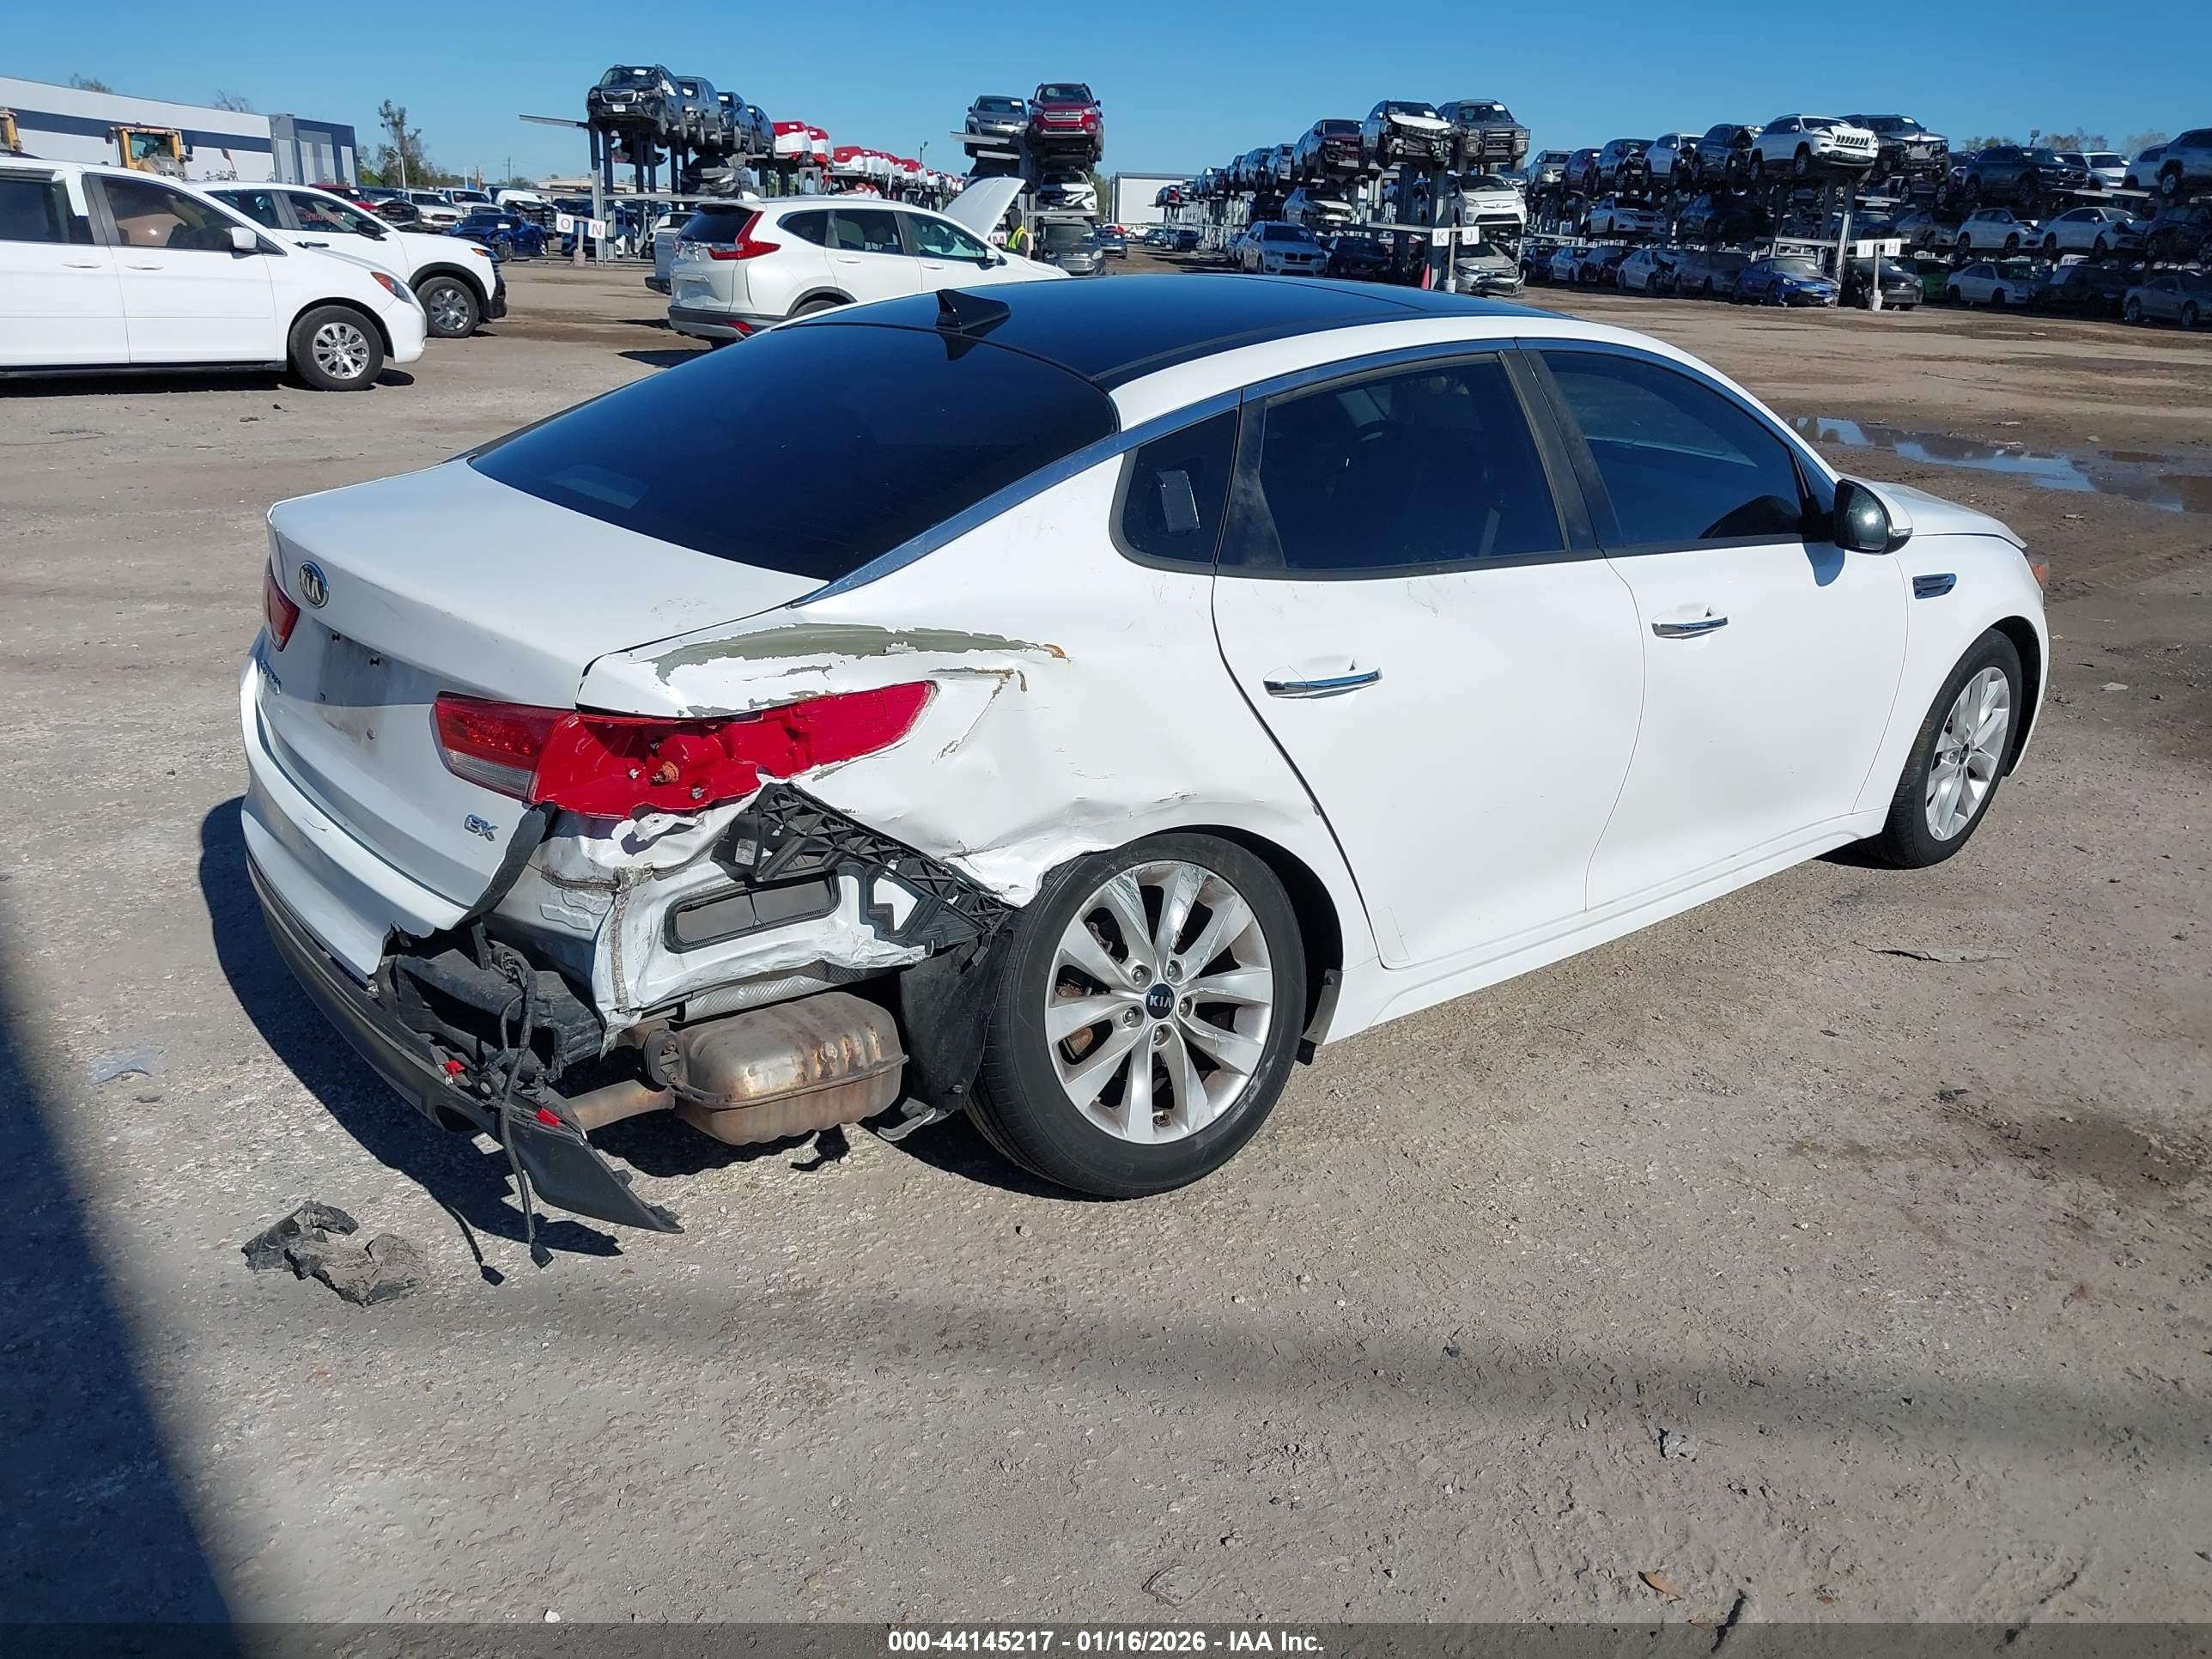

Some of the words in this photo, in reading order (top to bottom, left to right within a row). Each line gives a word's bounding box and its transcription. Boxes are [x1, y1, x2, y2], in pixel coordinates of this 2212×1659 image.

[561, 218, 571, 230] O
[592, 223, 603, 236] N
[1436, 231, 1445, 243] K
[1466, 230, 1474, 241] J
[1888, 242, 1898, 253] H
[300, 565, 322, 603] KIA
[464, 813, 499, 842] EX
[1149, 994, 1172, 1008] KIA
